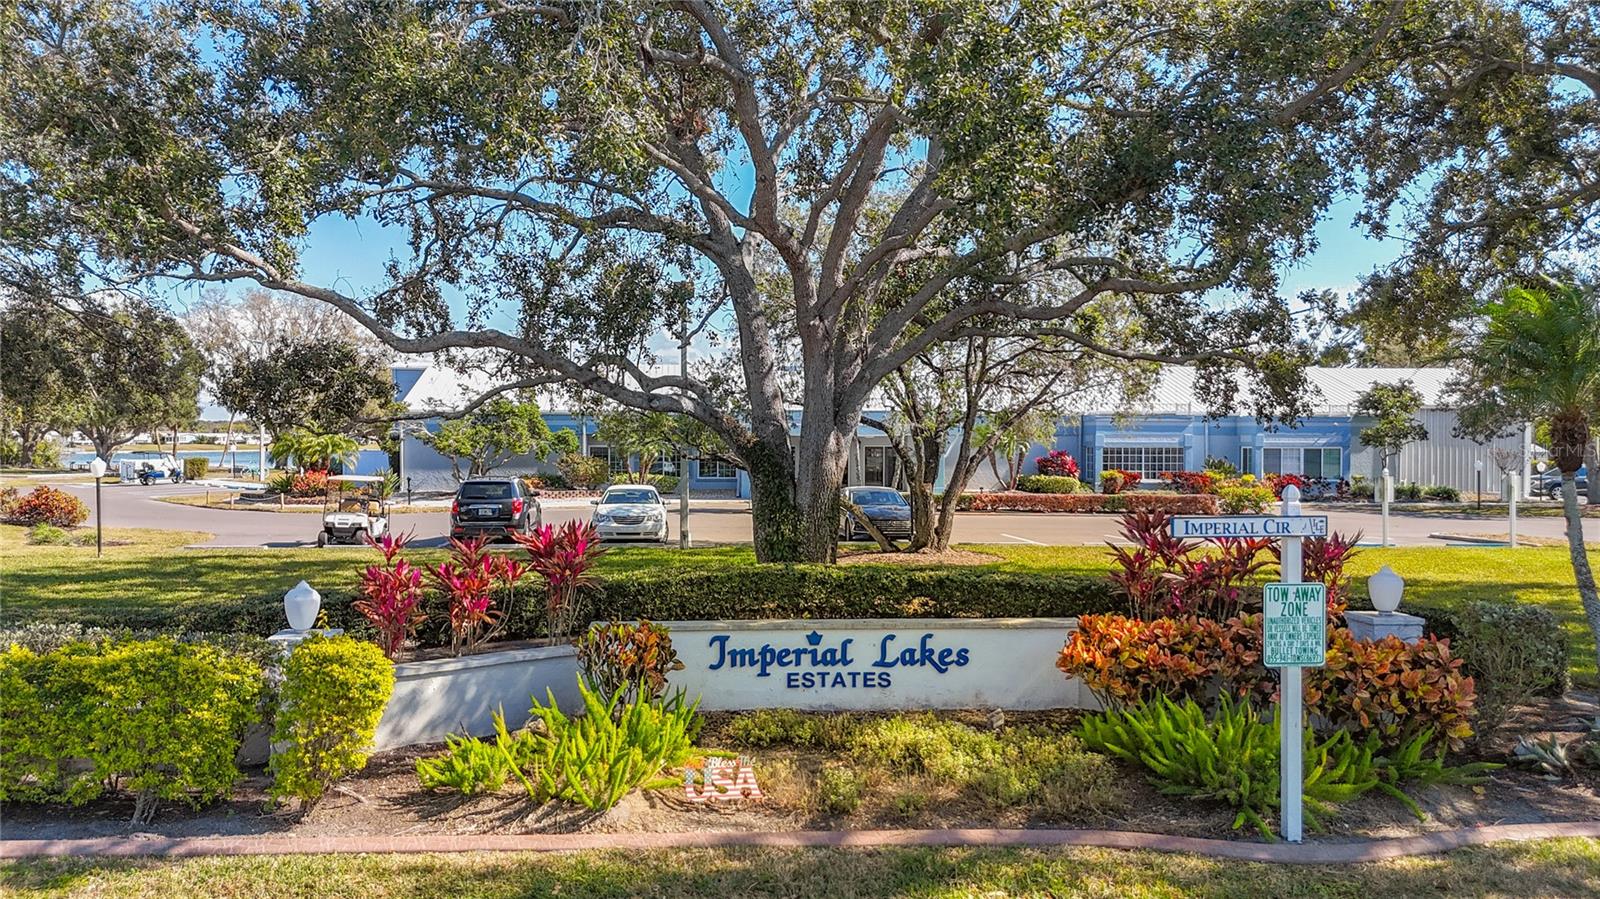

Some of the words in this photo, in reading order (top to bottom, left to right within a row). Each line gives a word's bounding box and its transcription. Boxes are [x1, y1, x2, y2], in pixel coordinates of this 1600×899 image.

[1183, 520, 1259, 534] IMPERIAL
[1263, 519, 1291, 534] CIR
[1268, 587, 1289, 602] TOW
[1294, 587, 1321, 602] AWAY
[1281, 602, 1308, 617] ZONE
[708, 632, 854, 677] Imperial
[872, 633, 970, 674] Lakes
[787, 672, 892, 689] ESTATES
[708, 756, 737, 768] Bless
[685, 767, 763, 801] USA
